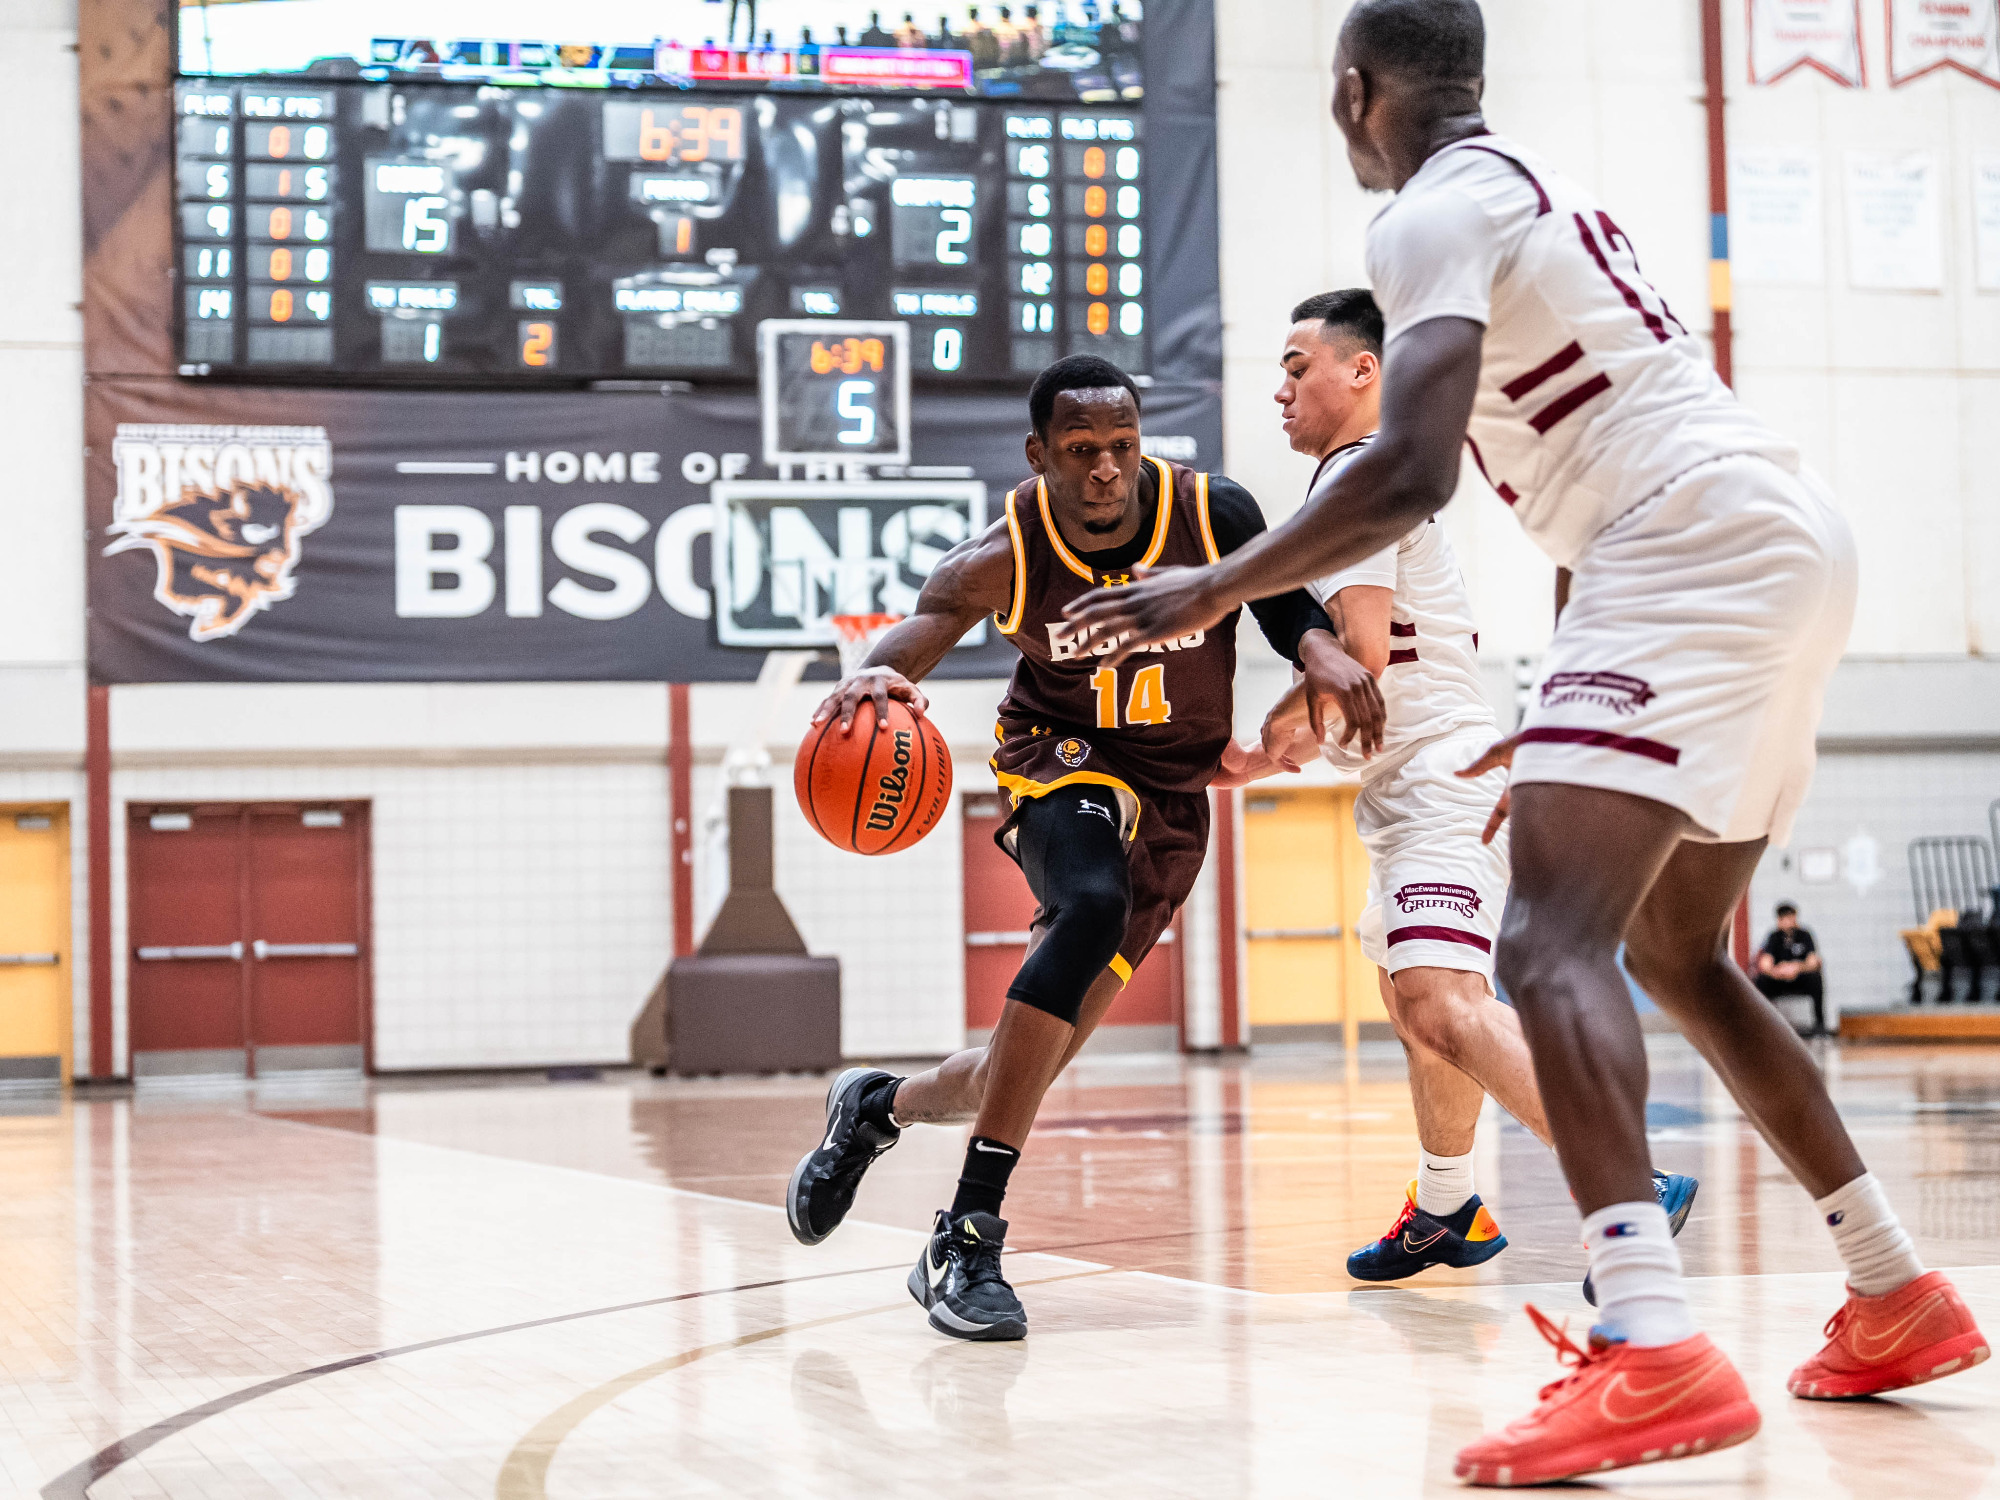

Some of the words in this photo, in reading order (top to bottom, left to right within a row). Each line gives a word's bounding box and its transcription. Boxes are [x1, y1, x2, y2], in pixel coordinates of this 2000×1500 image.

[639, 107, 742, 161] 6:39
[206, 164, 229, 198] 5
[206, 205, 229, 236] 9
[402, 196, 448, 252] 15
[676, 218, 691, 253] 1
[935, 209, 972, 264] 2
[198, 248, 231, 277] 11
[1022, 303, 1054, 332] 11
[424, 323, 440, 362] 1
[522, 323, 553, 366] 2
[810, 337, 885, 375] 6:39
[933, 328, 962, 371] 0
[837, 380, 876, 445] 5
[114, 439, 333, 533] BISONS
[504, 450, 662, 484] HOME
[681, 451, 749, 484] OF
[394, 502, 967, 621] BISONS
[1089, 663, 1172, 729] 14
[865, 729, 913, 832] Wilson
[1401, 899, 1475, 918] GRIFFINS
[1404, 886, 1438, 894] MacEwan
[1440, 886, 1474, 898] University
